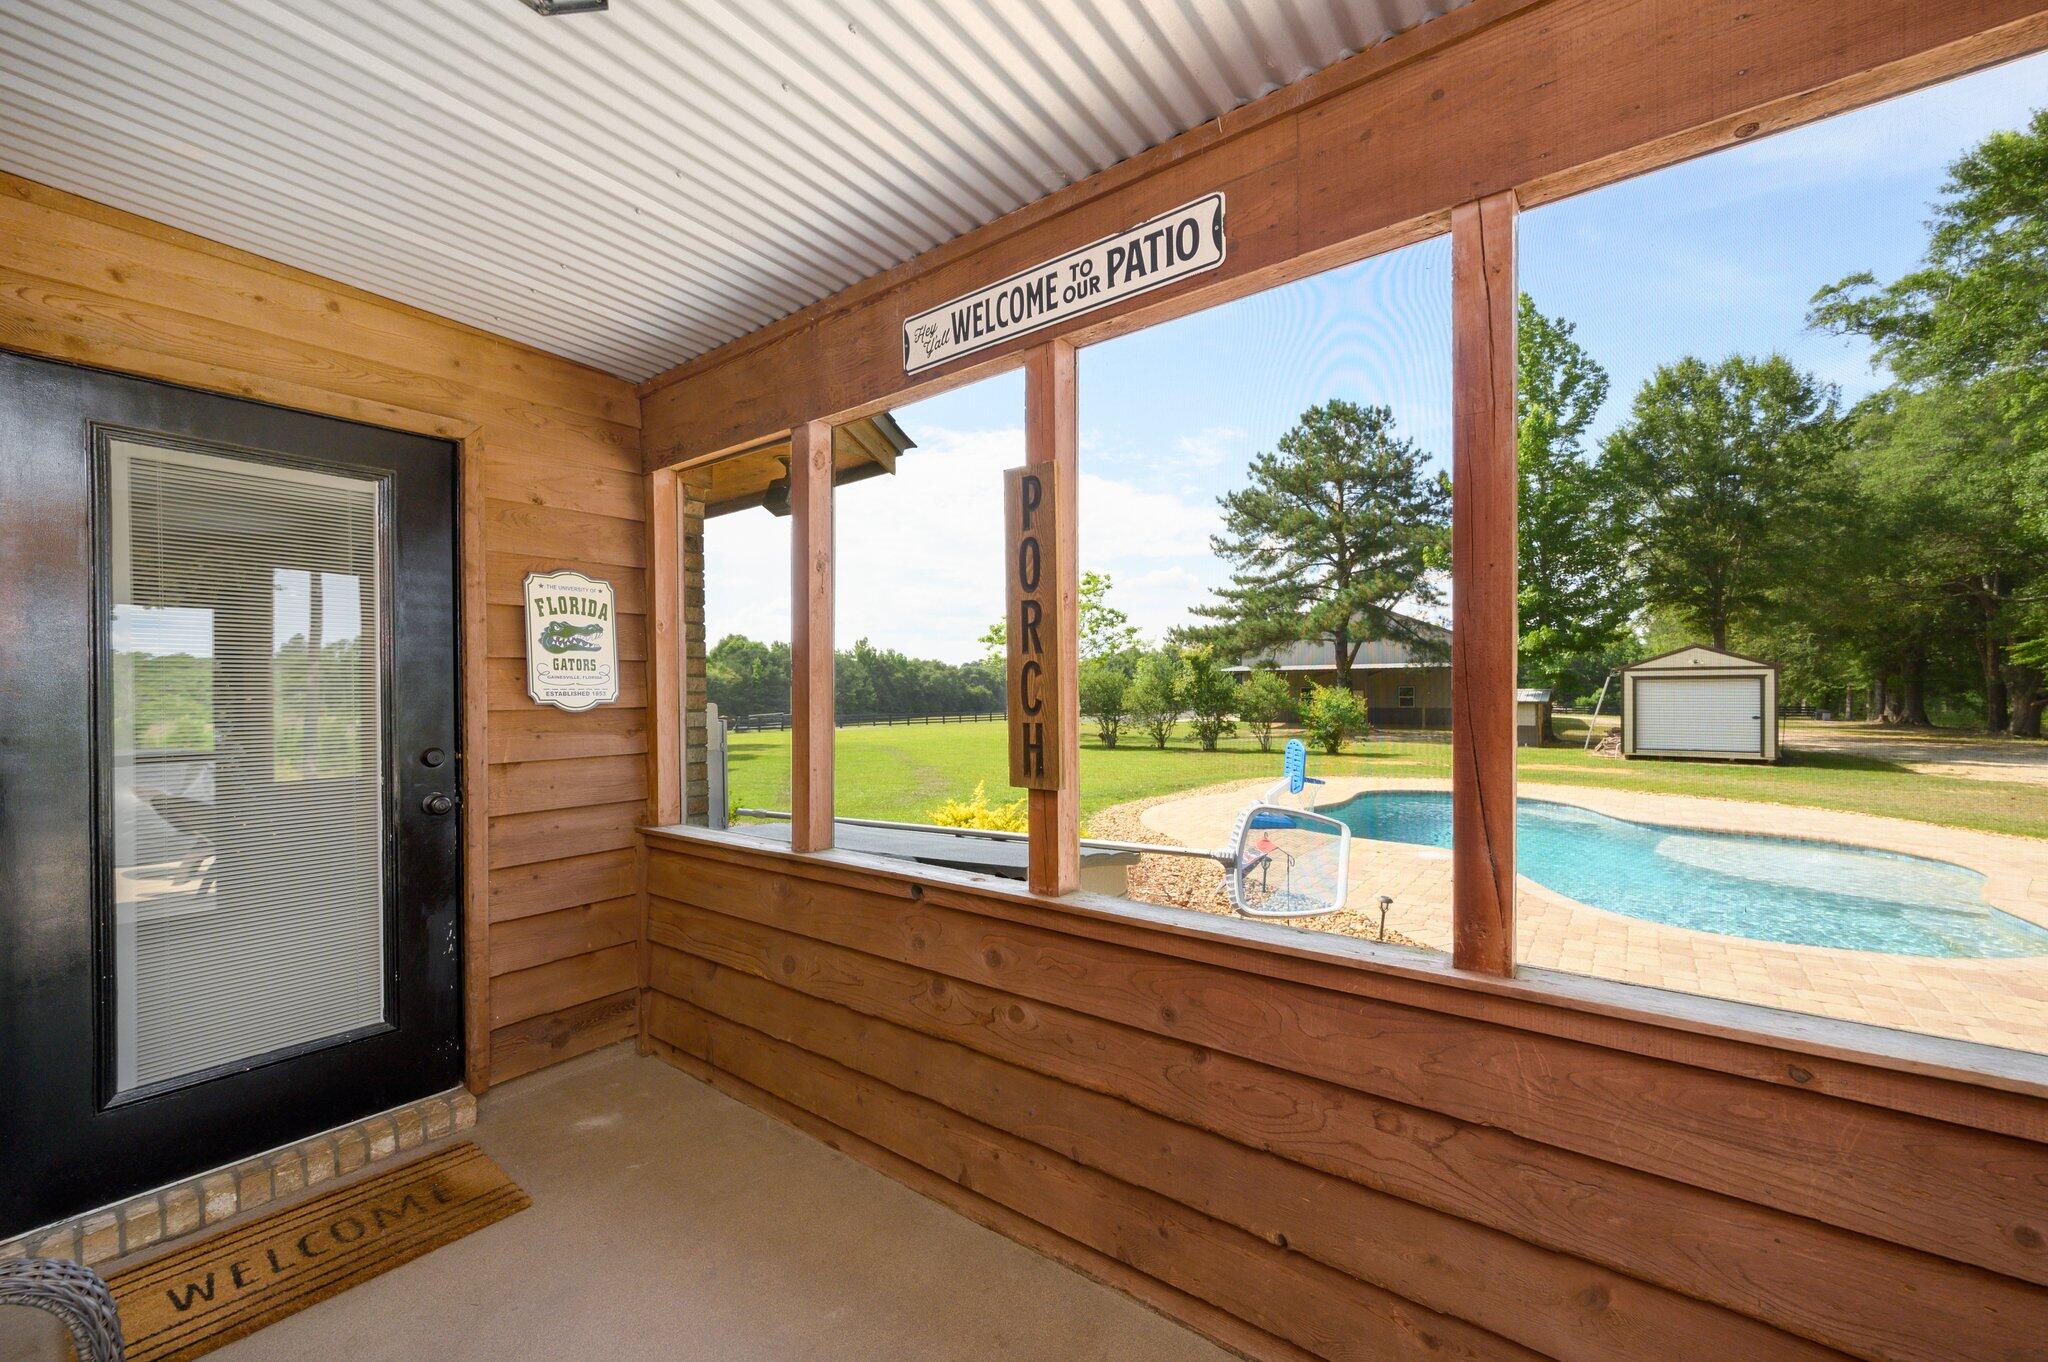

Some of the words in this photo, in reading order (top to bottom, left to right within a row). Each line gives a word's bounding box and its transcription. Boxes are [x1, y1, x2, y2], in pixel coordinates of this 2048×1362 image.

[1106, 217, 1200, 289] PATIO
[1069, 259, 1093, 282] TO
[1063, 275, 1100, 304] OUR
[951, 271, 1059, 345] WELCOME
[914, 323, 938, 343] Hey
[534, 595, 608, 621] FLORIDA
[1018, 474, 1043, 778] PORCH
[553, 658, 597, 672] GATORS
[166, 1181, 456, 1312] WELCOME
